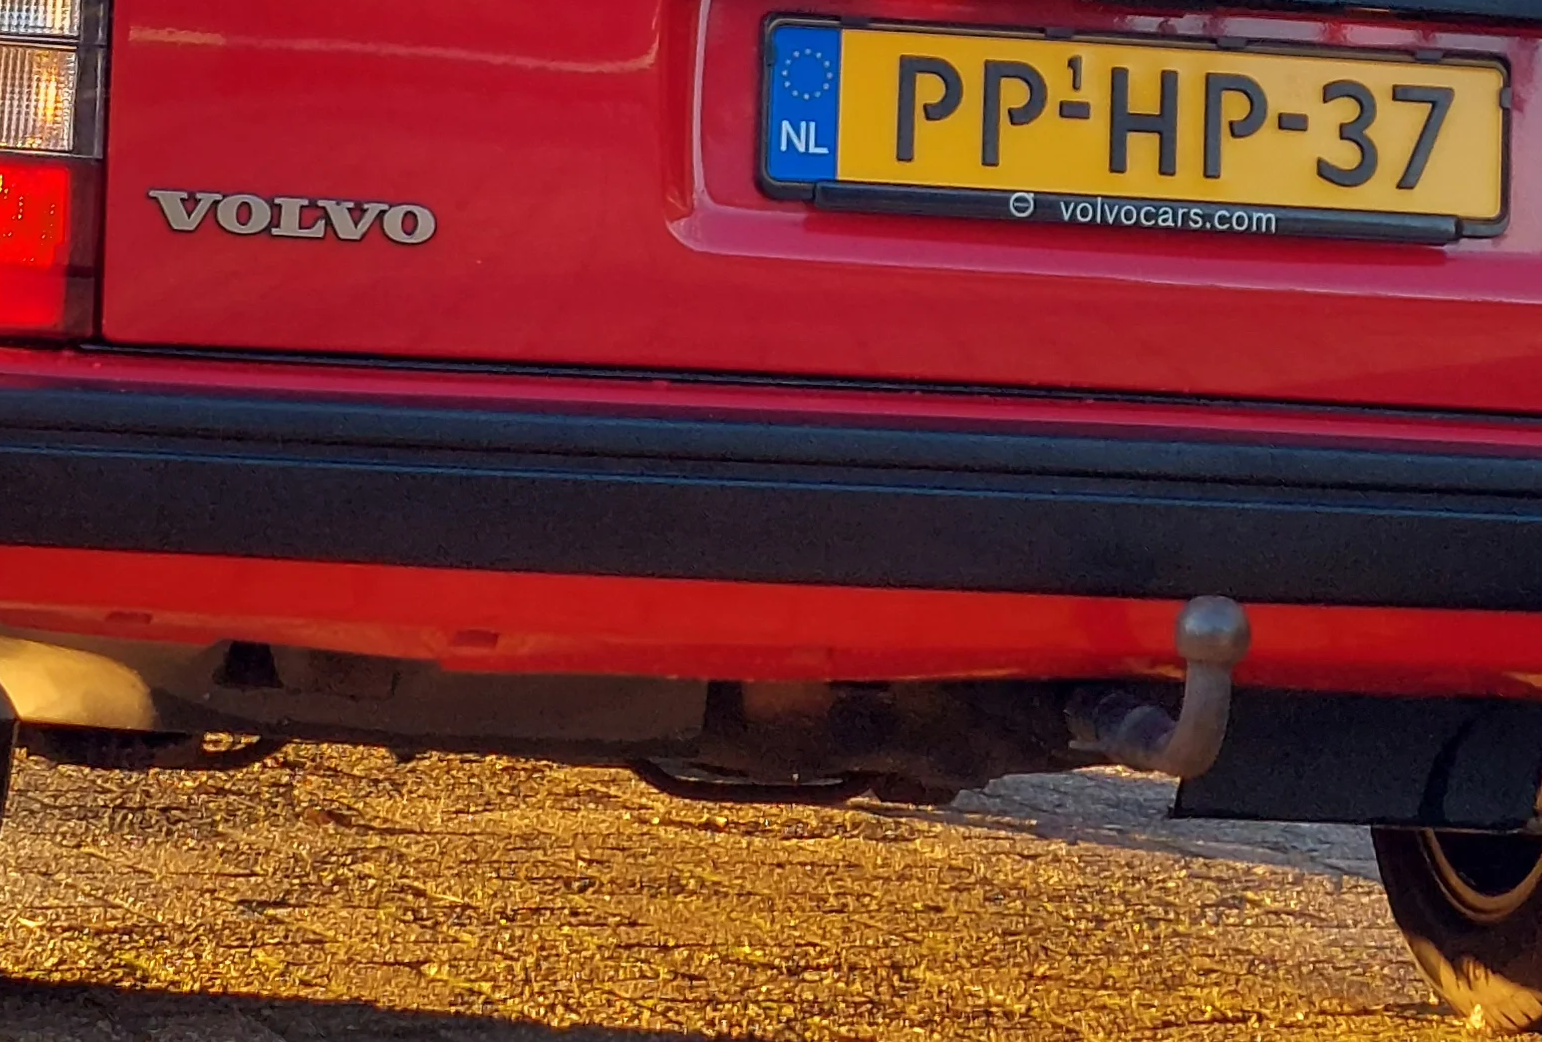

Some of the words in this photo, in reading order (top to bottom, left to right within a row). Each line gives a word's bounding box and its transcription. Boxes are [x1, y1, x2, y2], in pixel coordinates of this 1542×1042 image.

[779, 120, 830, 156] NL
[148, 189, 437, 245] VOLVO
[1059, 196, 1278, 234] volvocars.com
